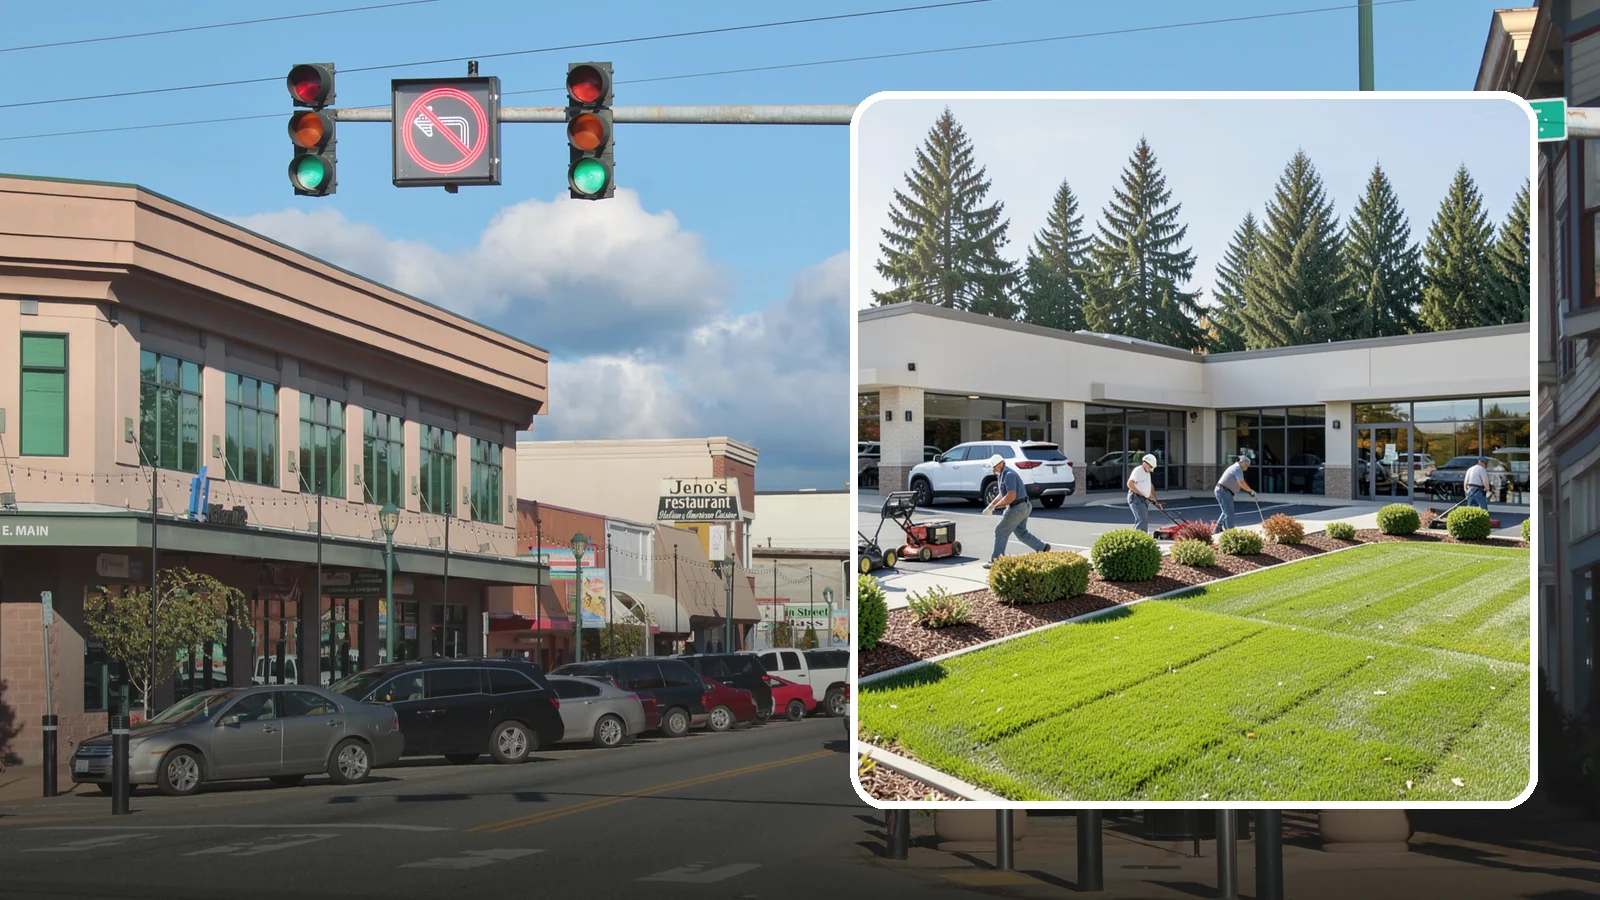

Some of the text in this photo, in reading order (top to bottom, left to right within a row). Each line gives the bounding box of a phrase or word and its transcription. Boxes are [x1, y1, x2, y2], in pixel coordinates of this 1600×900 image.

[670, 480, 727, 494] Jeno's
[665, 496, 731, 508] restaurant
[658, 510, 681, 519] Italian
[685, 510, 714, 519] American
[715, 510, 737, 519] Cuisine
[2, 525, 49, 536] E. MAIN
[797, 608, 828, 616] Street
